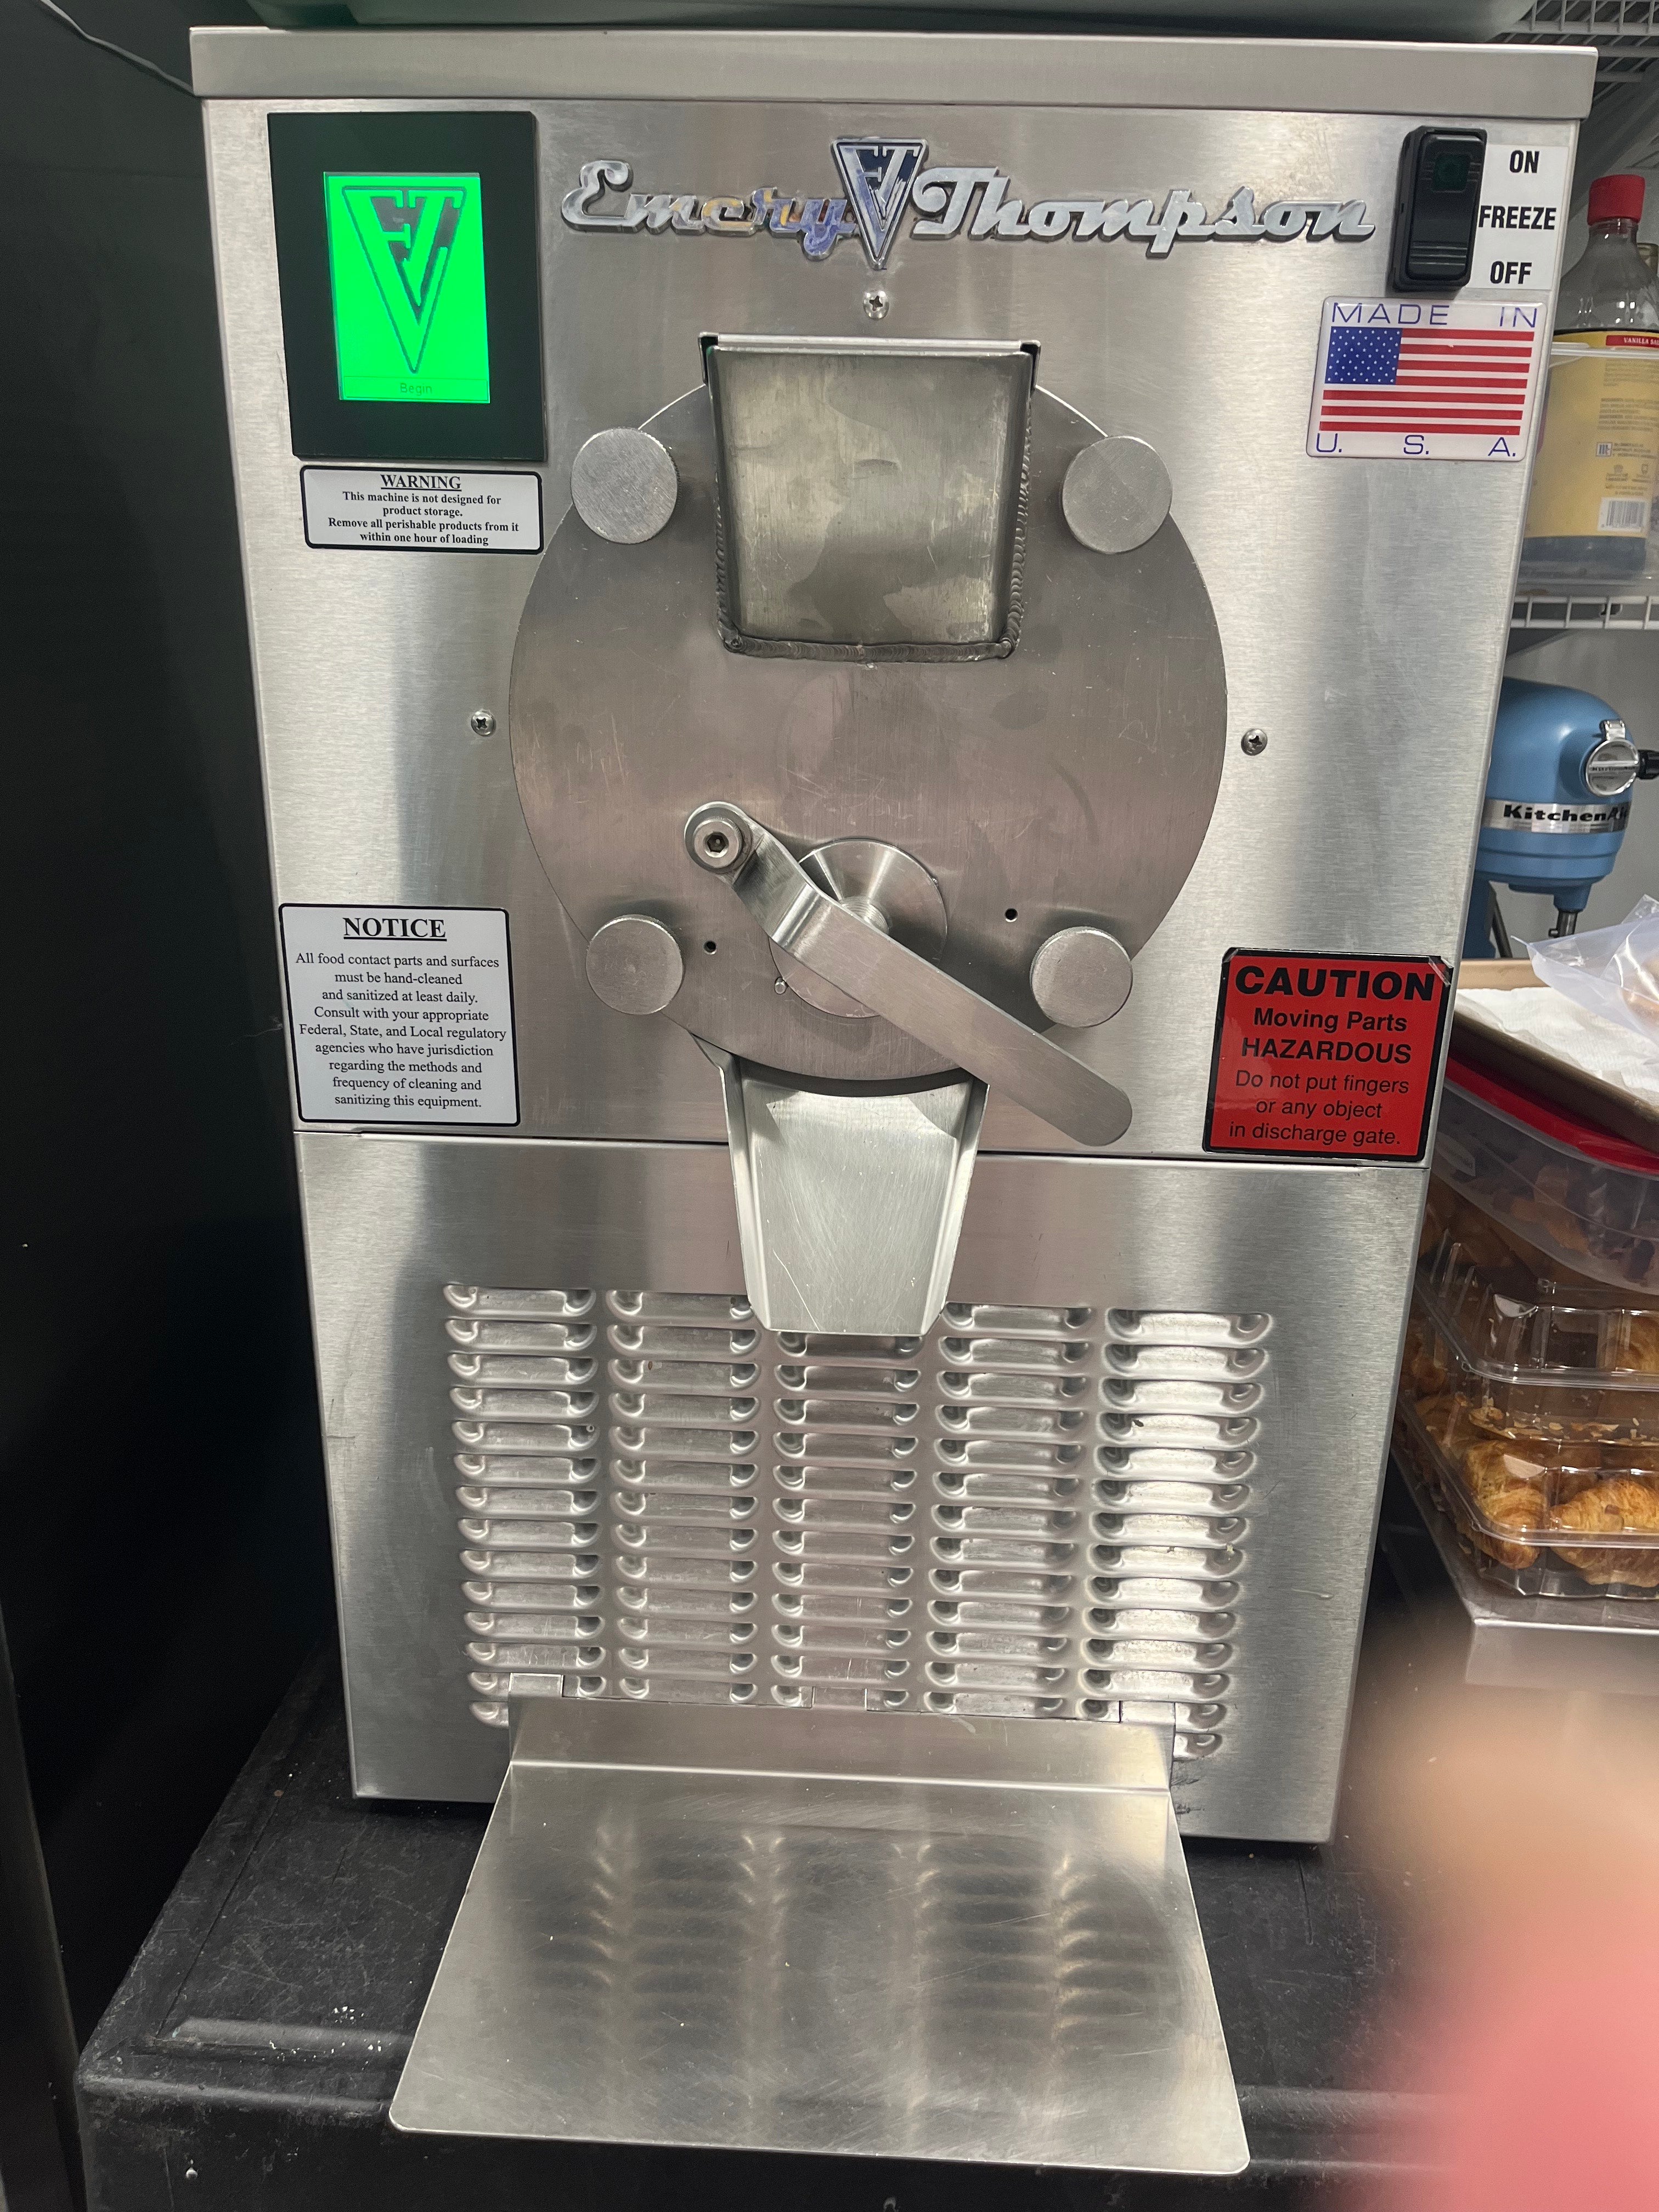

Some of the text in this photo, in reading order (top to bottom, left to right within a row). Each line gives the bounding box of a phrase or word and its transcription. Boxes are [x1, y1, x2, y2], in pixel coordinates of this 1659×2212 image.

[1510, 150, 1539, 173] ON
[561, 159, 860, 261] Emery
[911, 165, 1376, 258] Thompson
[1479, 205, 1556, 230] FREEZE
[1491, 261, 1532, 284] OFF
[1331, 302, 1537, 328] MADE IN
[400, 382, 432, 396] Begin
[1317, 433, 1516, 457] U. S. A.
[381, 474, 461, 489] WARNING
[343, 492, 364, 500] This
[368, 493, 409, 501] machine
[412, 493, 419, 502] is
[442, 494, 483, 506] designed
[487, 495, 501, 504] for
[383, 506, 462, 518] product storage.
[328, 518, 518, 532] Remove all perishable products from it
[360, 532, 391, 541] within
[414, 533, 437, 542] hour
[441, 534, 450, 543] of
[452, 534, 488, 546] loading
[342, 917, 445, 938] NOTICE
[296, 953, 499, 968] All food contact parts and surfaces
[335, 972, 462, 984] must be hand-cleaned
[1236, 964, 1436, 1001] CAUTION
[323, 989, 477, 1005] and sanitized at least daily.
[315, 1007, 488, 1023] Consult with your appropriate
[1255, 1008, 1407, 1033] Moving Parts
[299, 1024, 506, 1041] Federal, State, and Local regulatory
[316, 1042, 494, 1057] agencies who have jurisdiction
[1243, 1037, 1411, 1064] HAZARDOUS
[329, 1060, 482, 1073] regarding the methods and
[333, 1077, 482, 1092] frequency of cleaning and
[1236, 1070, 1409, 1097] Do not put fingers
[335, 1094, 481, 1109] sanitizing this equipment.
[1256, 1100, 1382, 1121] or any object
[1229, 1121, 1400, 1146] in discharge gate.
